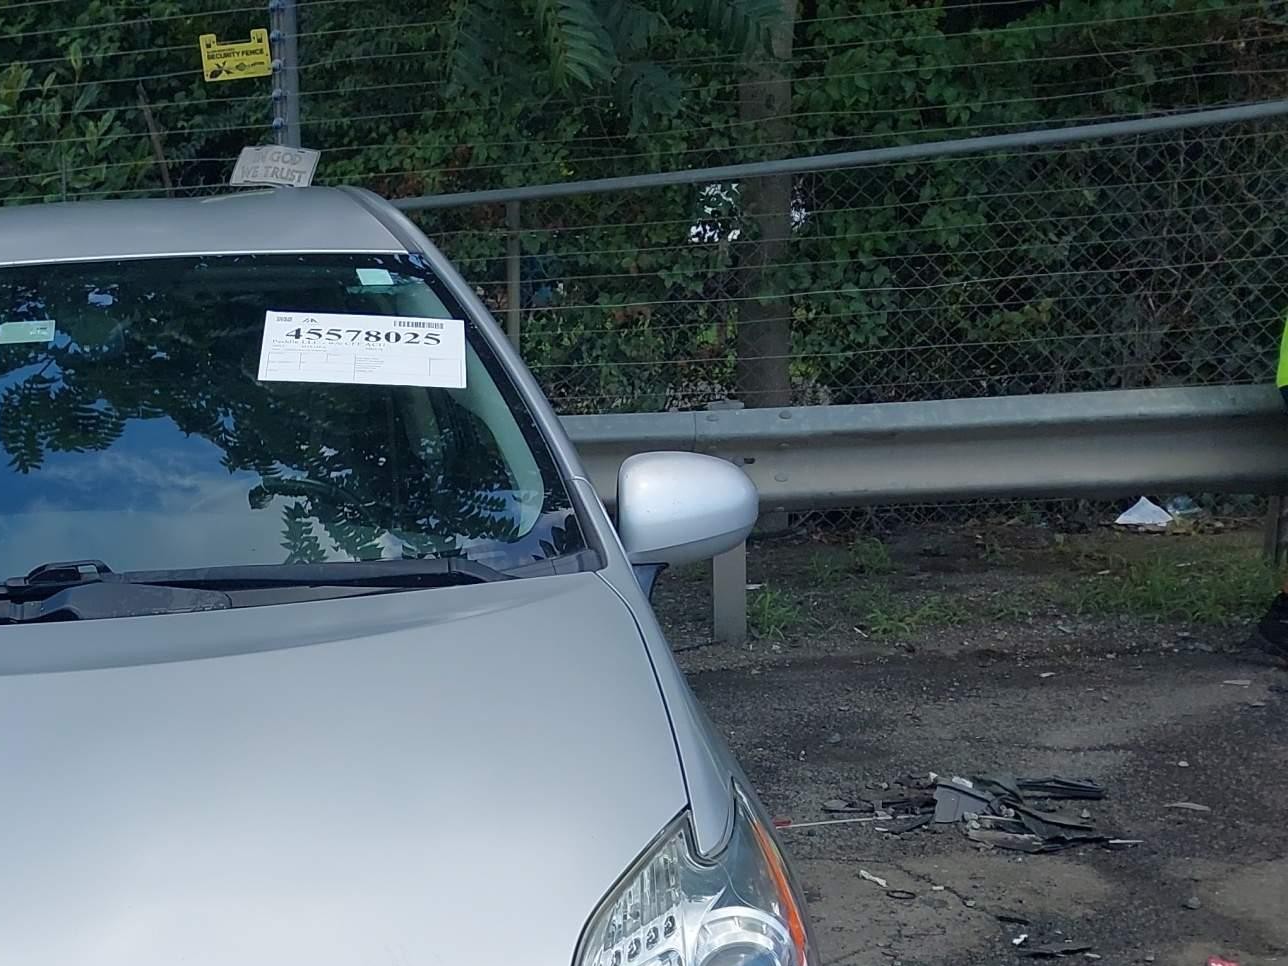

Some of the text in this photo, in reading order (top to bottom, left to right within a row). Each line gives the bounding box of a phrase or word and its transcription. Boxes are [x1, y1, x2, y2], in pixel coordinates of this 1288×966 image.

[206, 50, 240, 60] SECURITY
[241, 48, 265, 57] FENCE
[271, 151, 303, 166] GOD
[263, 165, 307, 183] TRUST
[285, 327, 441, 346] 45578025
